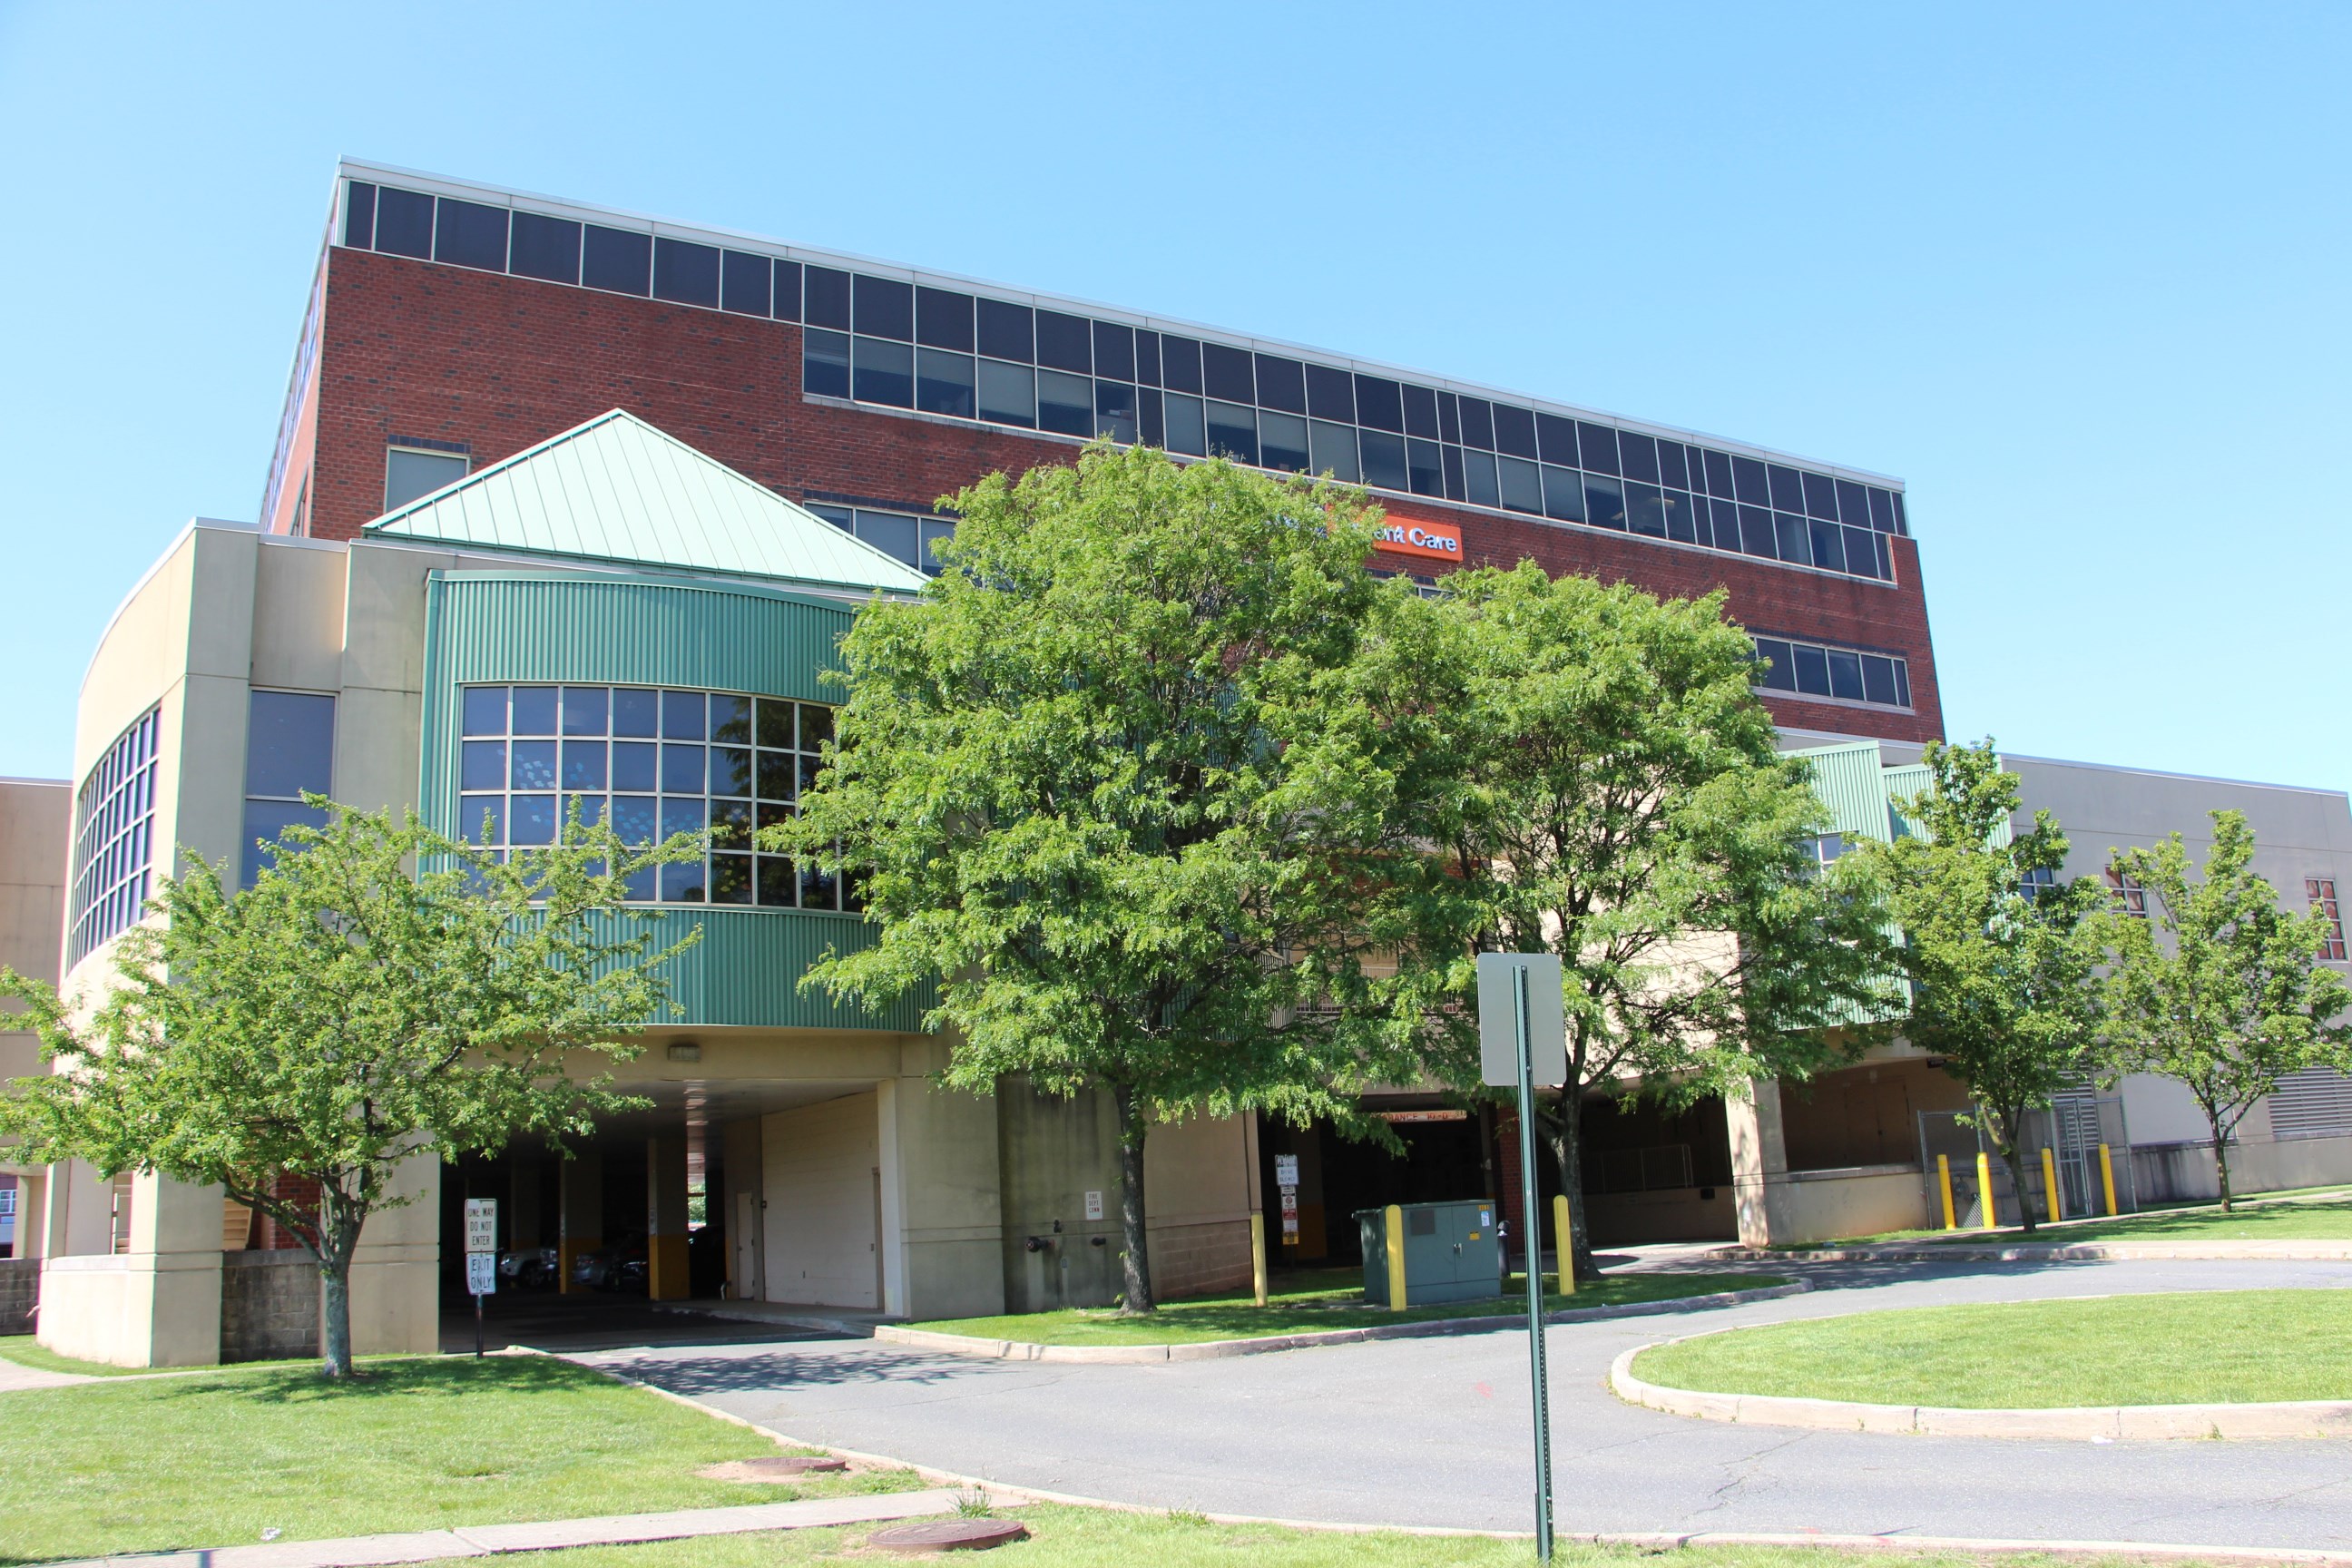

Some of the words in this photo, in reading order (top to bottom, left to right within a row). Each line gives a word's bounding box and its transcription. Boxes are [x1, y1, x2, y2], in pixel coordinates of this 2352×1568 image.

[1374, 525, 1406, 544] ent
[1408, 527, 1457, 552] Care
[1382, 1113, 1417, 1122] RANCE
[468, 1208, 480, 1217] ONE
[483, 1208, 494, 1217] WAY
[470, 1221, 478, 1231] DO
[481, 1221, 492, 1231] NOT
[472, 1236, 490, 1246] ENTER
[472, 1259, 491, 1270] EXIT
[470, 1277, 491, 1289] ONLY
